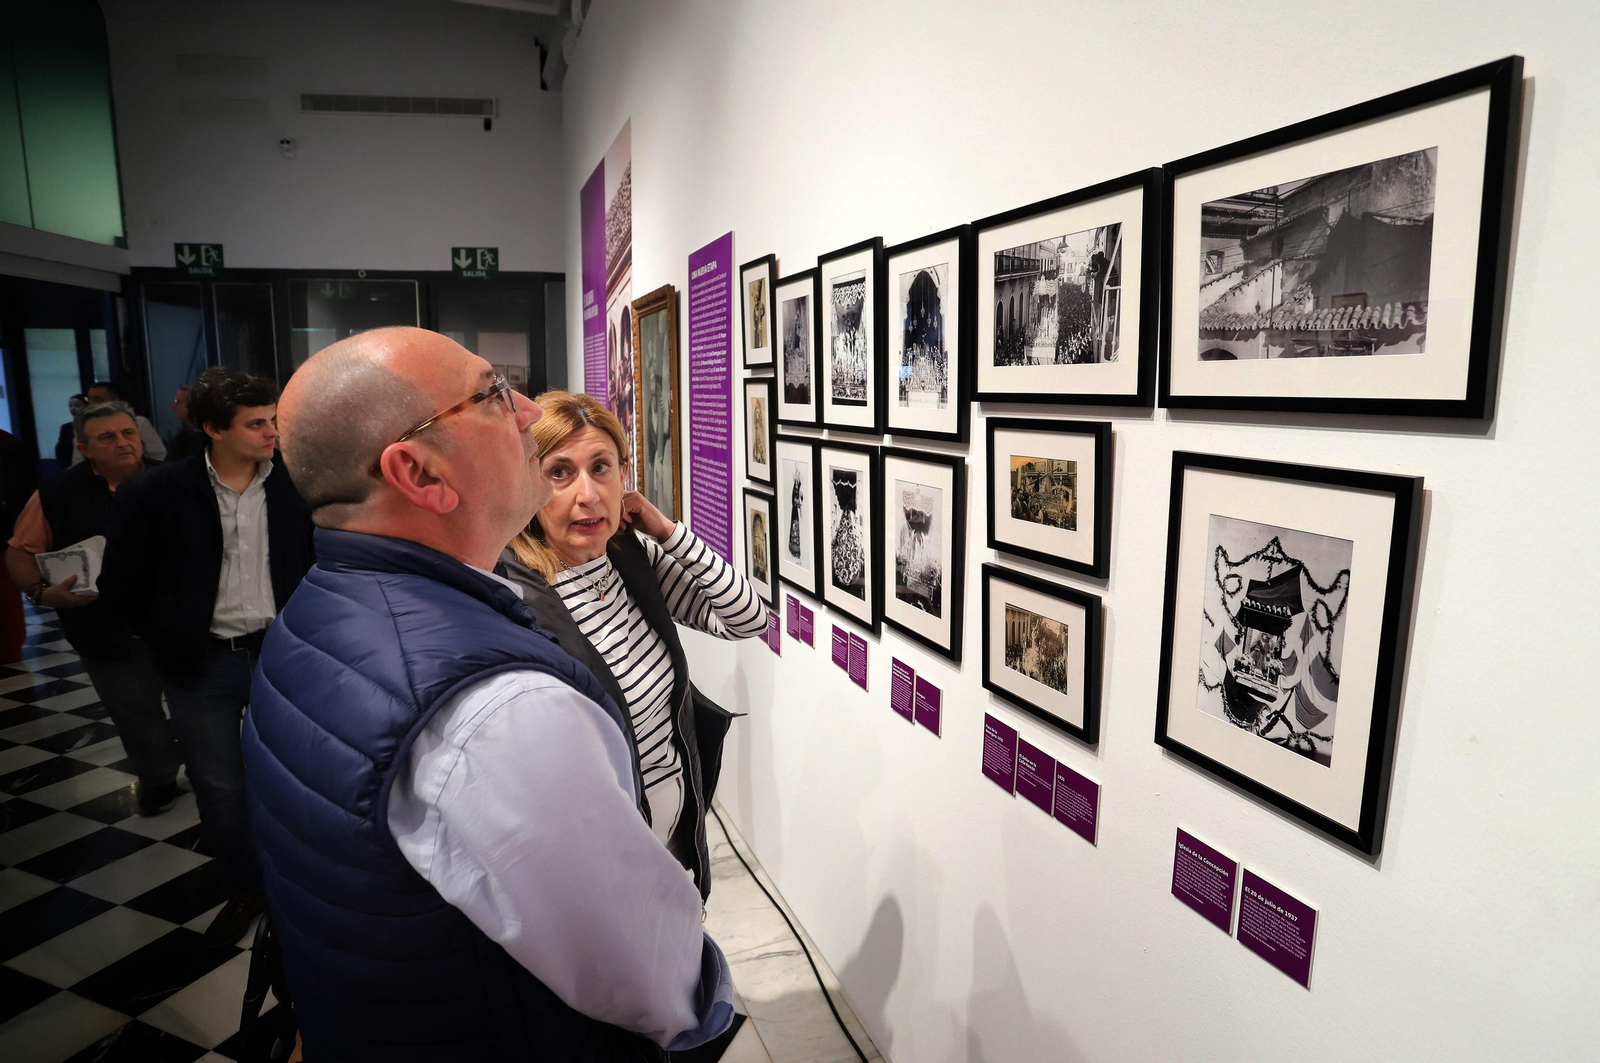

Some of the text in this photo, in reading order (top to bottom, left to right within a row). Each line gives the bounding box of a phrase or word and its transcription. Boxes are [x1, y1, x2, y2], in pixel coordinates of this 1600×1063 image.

[462, 270, 486, 278] SALIDA
[1178, 842, 1192, 854] Iglesia
[1203, 857, 1229, 877] Concepción
[1244, 886, 1298, 922] El 20 de julio de 1937
